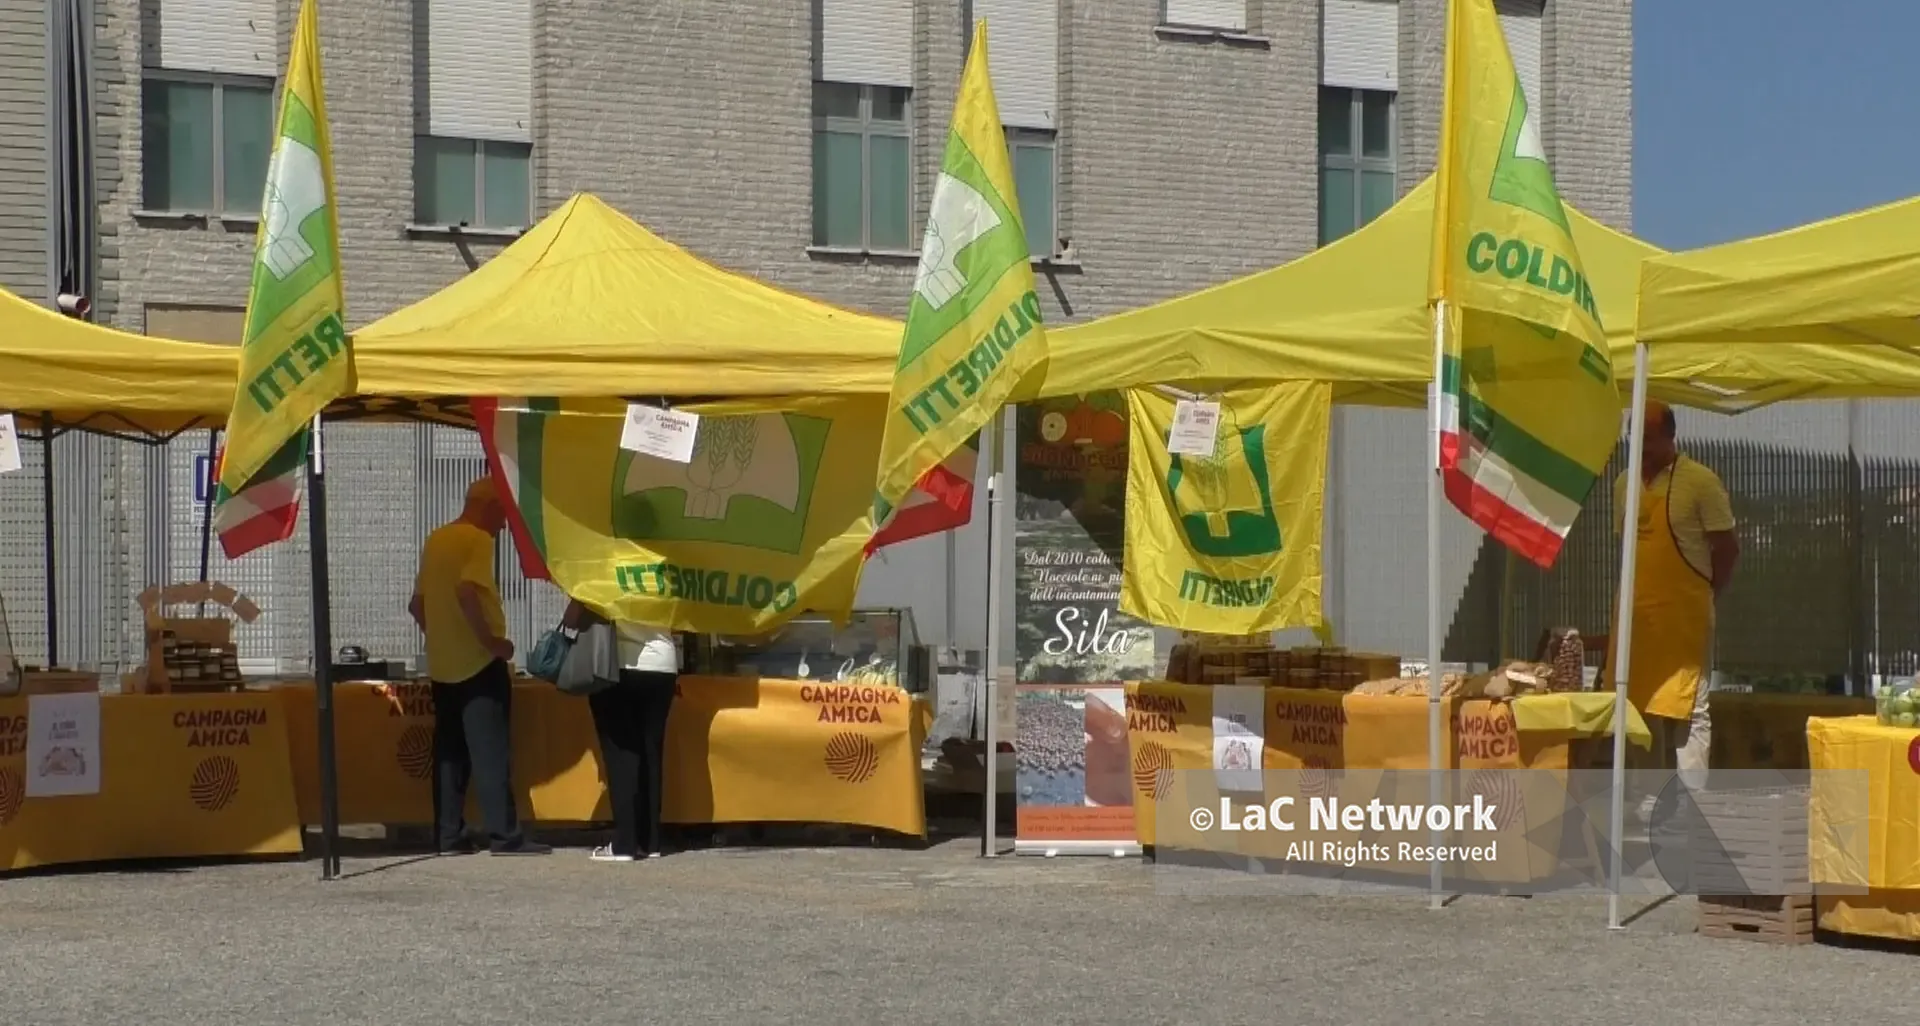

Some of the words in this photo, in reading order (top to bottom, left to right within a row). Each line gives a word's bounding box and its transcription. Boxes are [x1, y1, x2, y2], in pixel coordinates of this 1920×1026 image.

[1467, 232, 1603, 324] COLDIR
[1024, 551, 1051, 565] Dal
[1054, 551, 1083, 565] 2010
[1043, 606, 1137, 655] Sila
[800, 686, 900, 704] CAMPAGNA
[1126, 694, 1187, 714] AMPAGNA
[173, 707, 267, 729] CAMPAGNA
[389, 699, 436, 717] AMIC
[817, 705, 882, 723] AMICA
[1276, 702, 1348, 725] CAMPAGNA
[1129, 711, 1178, 733] AMICA
[187, 729, 250, 748] AMICA
[1292, 725, 1338, 746] AMICA
[1460, 736, 1519, 759] AMICA
